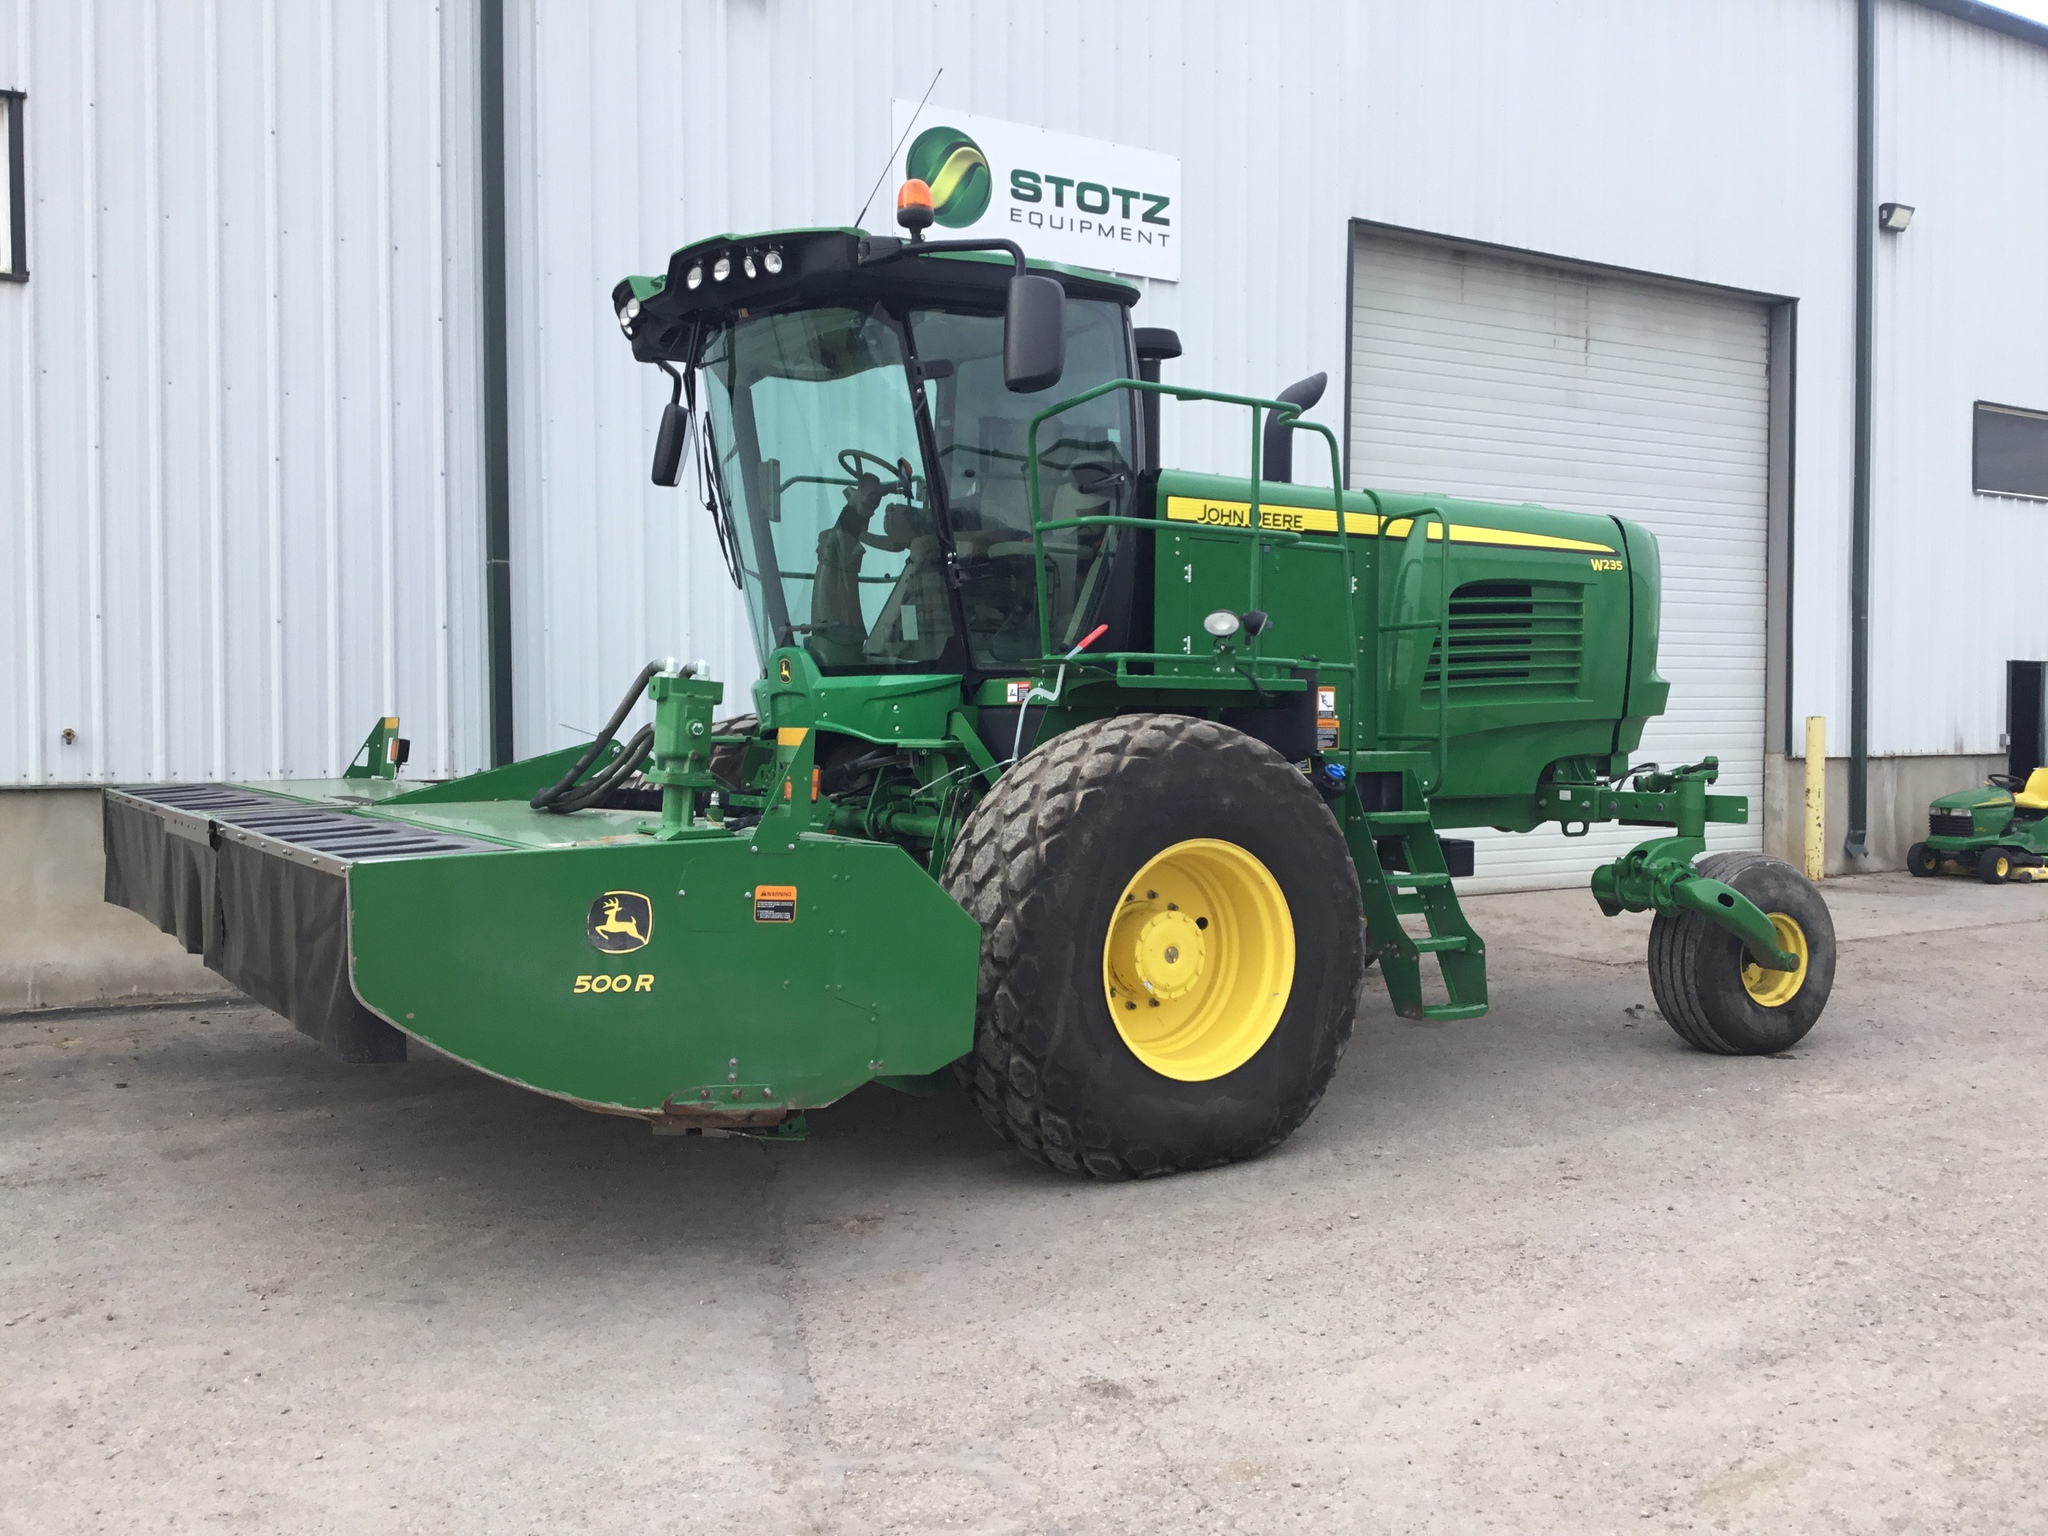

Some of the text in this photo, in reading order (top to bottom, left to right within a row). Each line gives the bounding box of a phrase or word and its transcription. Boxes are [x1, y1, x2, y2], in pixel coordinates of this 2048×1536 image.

[1010, 168, 1170, 226] STOTZ
[1010, 207, 1170, 247] EQUIPMENT
[1197, 503, 1244, 524] JOHN
[1590, 558, 1623, 571] W235
